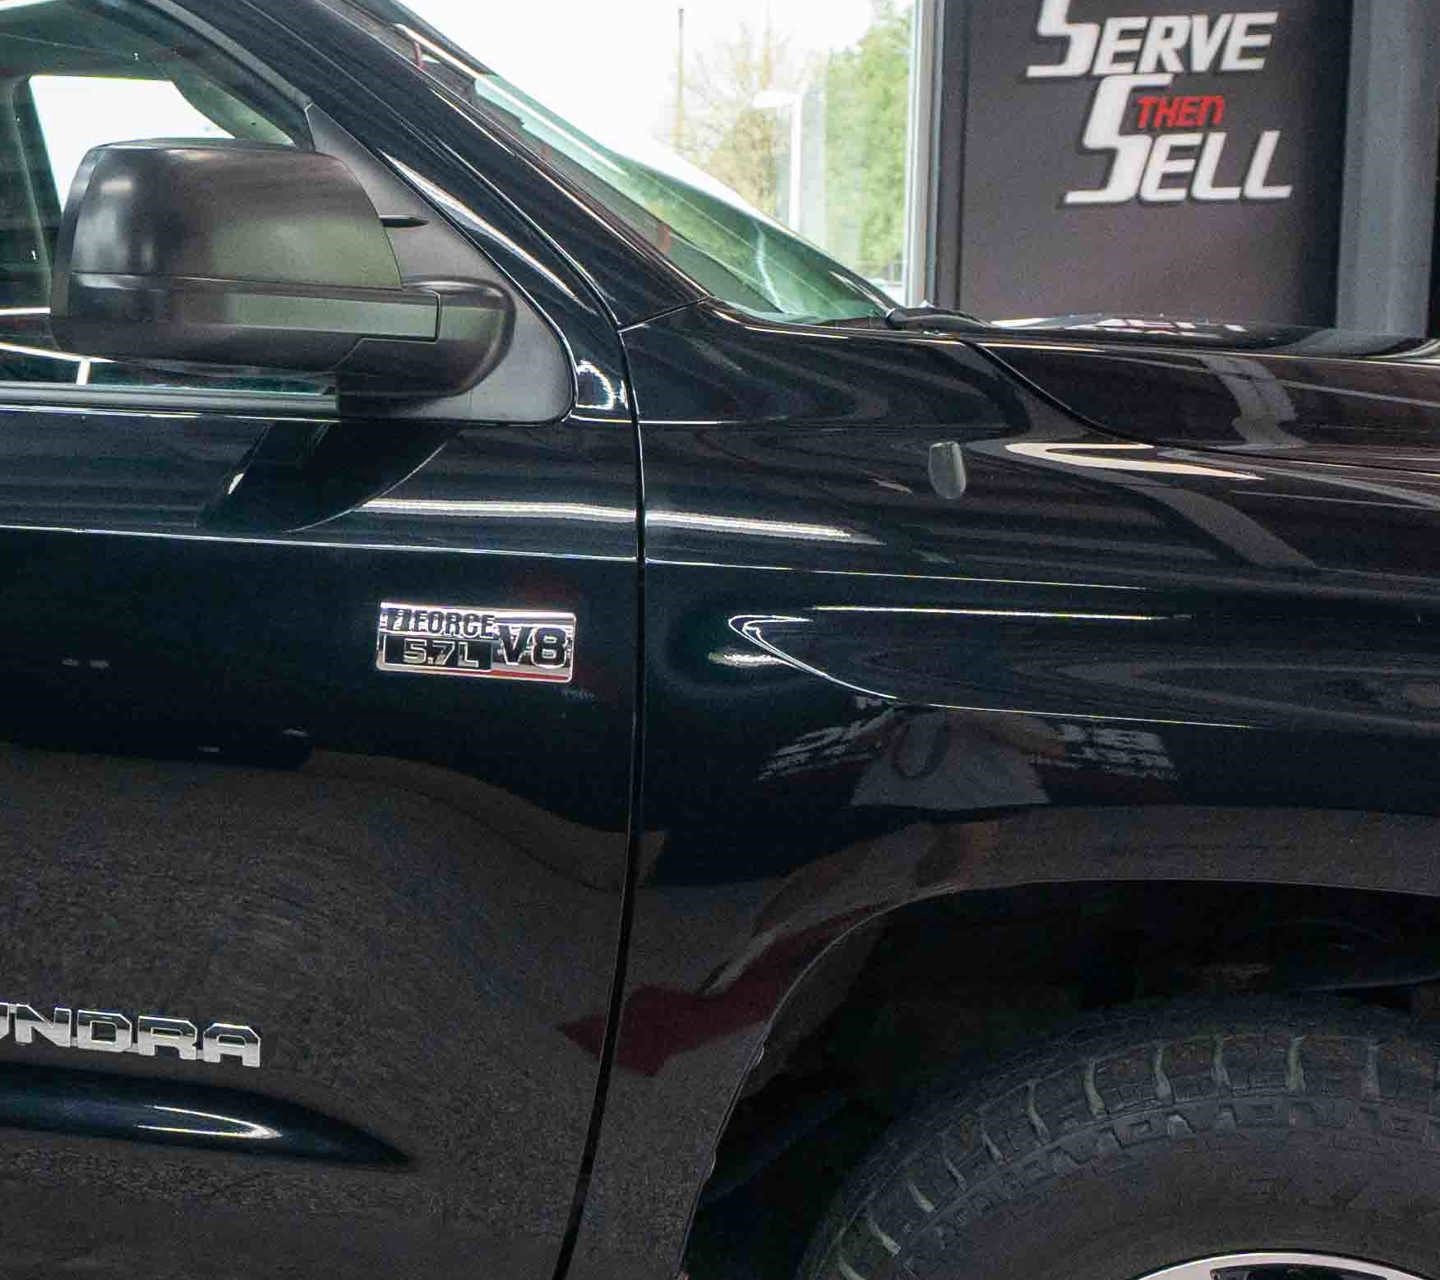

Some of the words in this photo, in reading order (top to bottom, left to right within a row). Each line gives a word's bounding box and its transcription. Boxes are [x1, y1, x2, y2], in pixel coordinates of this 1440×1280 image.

[1135, 95, 1226, 129] THEN
[1063, 73, 1293, 204] SELL
[402, 637, 480, 668] 5.7L
[497, 623, 570, 669] V8
